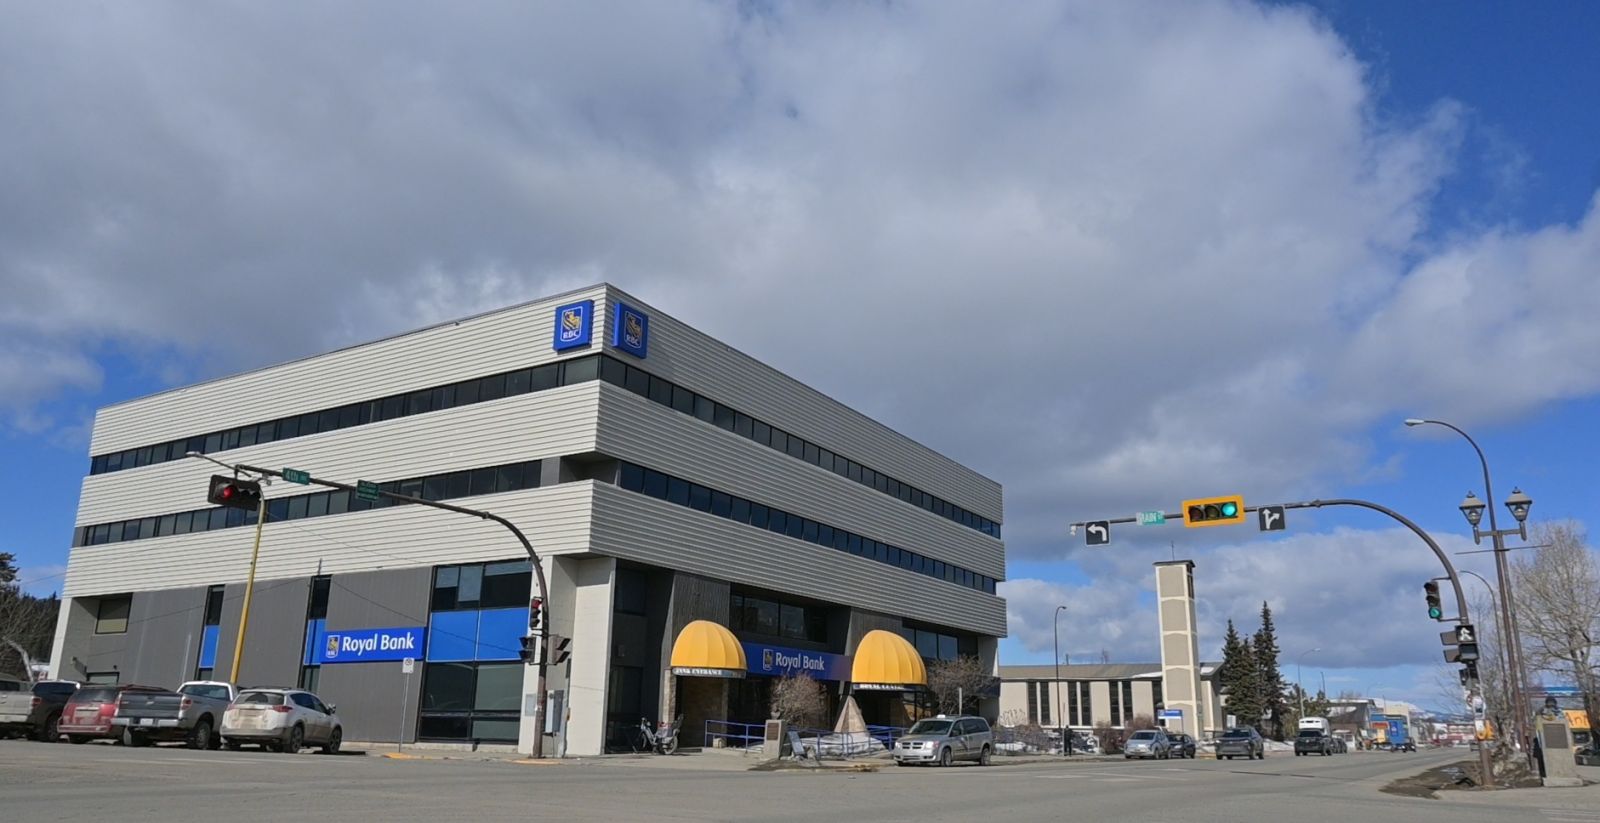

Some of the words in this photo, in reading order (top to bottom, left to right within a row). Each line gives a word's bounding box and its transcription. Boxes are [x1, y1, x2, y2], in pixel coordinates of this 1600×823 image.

[563, 329, 579, 339] RBC
[626, 335, 639, 346] RBC
[342, 633, 378, 656] Royal
[380, 632, 415, 650] Bank
[775, 652, 801, 672] Royal
[803, 655, 825, 671] Bank
